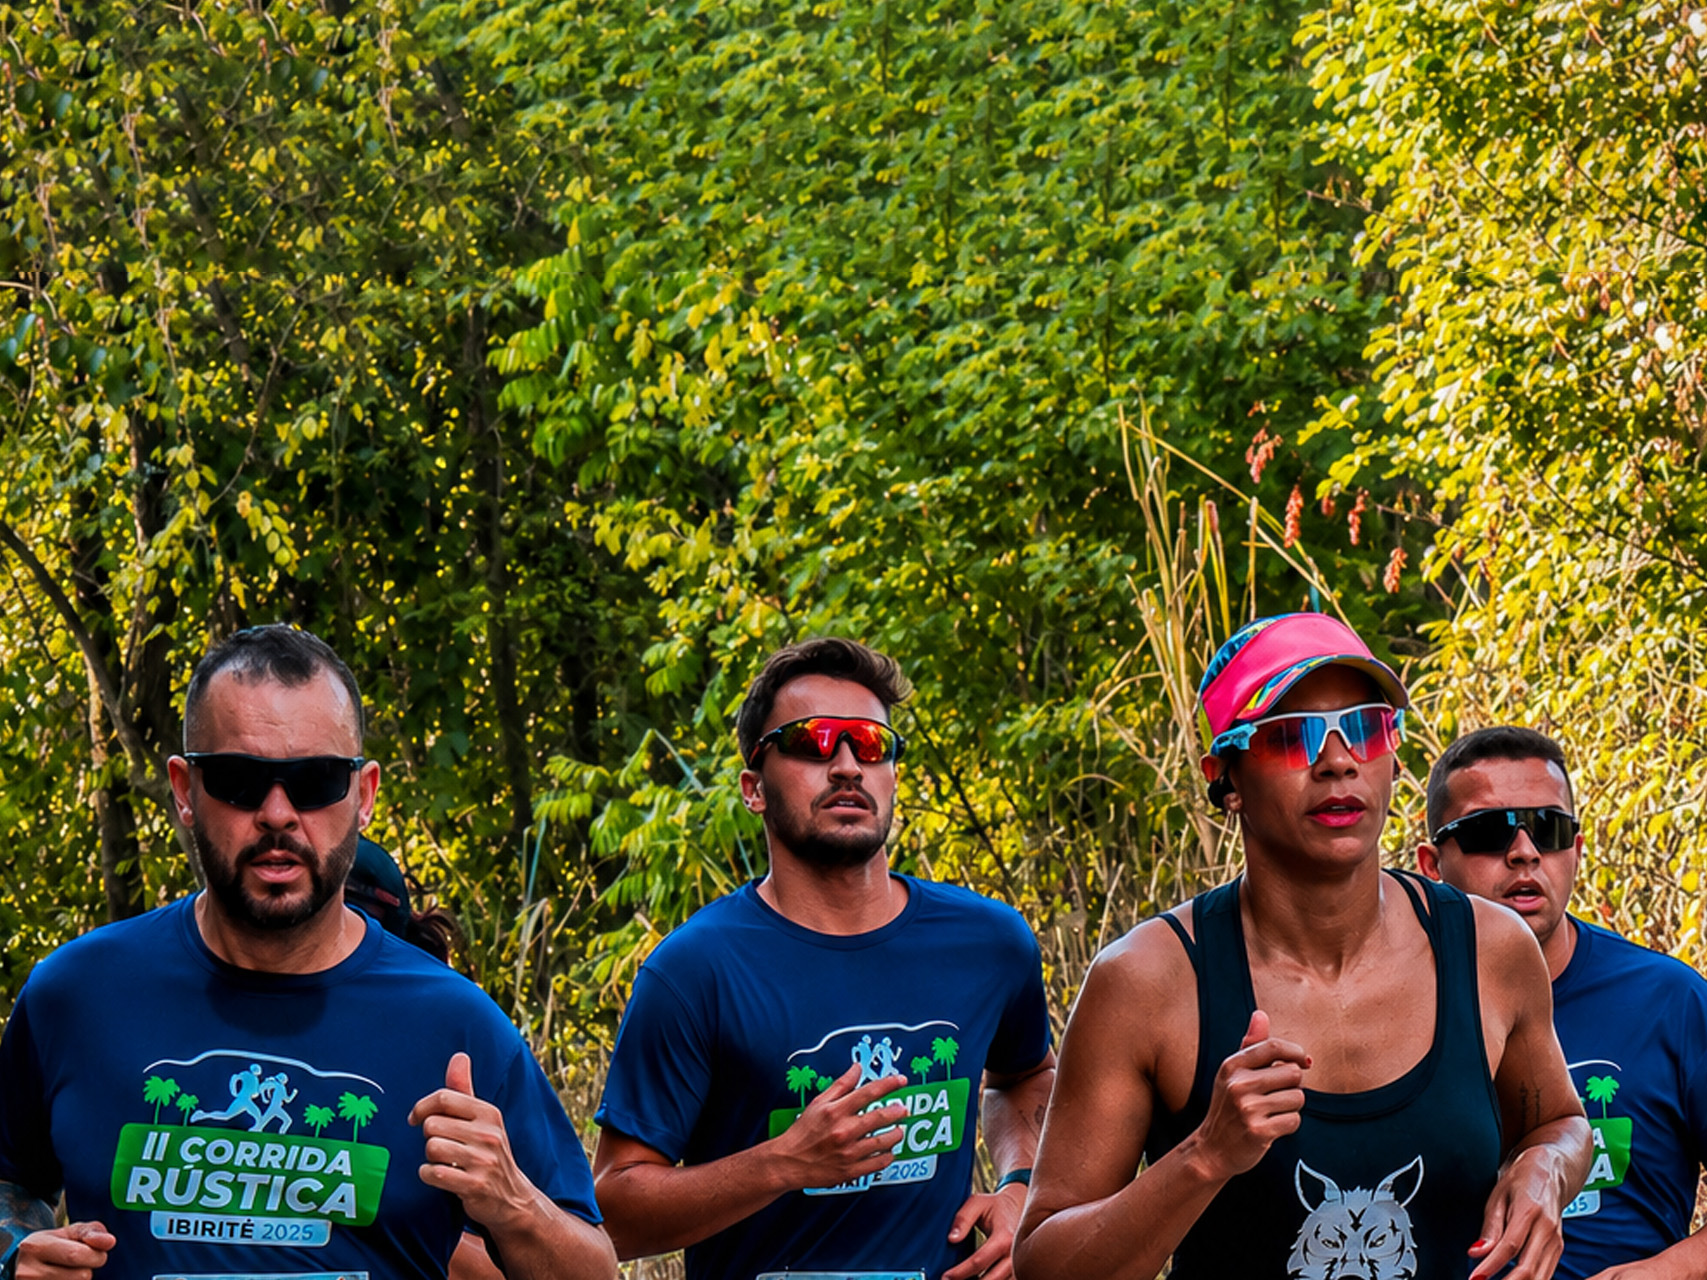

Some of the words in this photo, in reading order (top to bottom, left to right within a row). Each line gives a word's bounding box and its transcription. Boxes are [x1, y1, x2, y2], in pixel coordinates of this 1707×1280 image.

[141, 1131, 171, 1162] II
[178, 1136, 353, 1177] CORRIDA
[889, 1160, 929, 1180] 2025
[125, 1165, 358, 1219] RÚSTICA
[166, 1218, 255, 1239] IBIRITÉ
[261, 1222, 314, 1241] 2025
